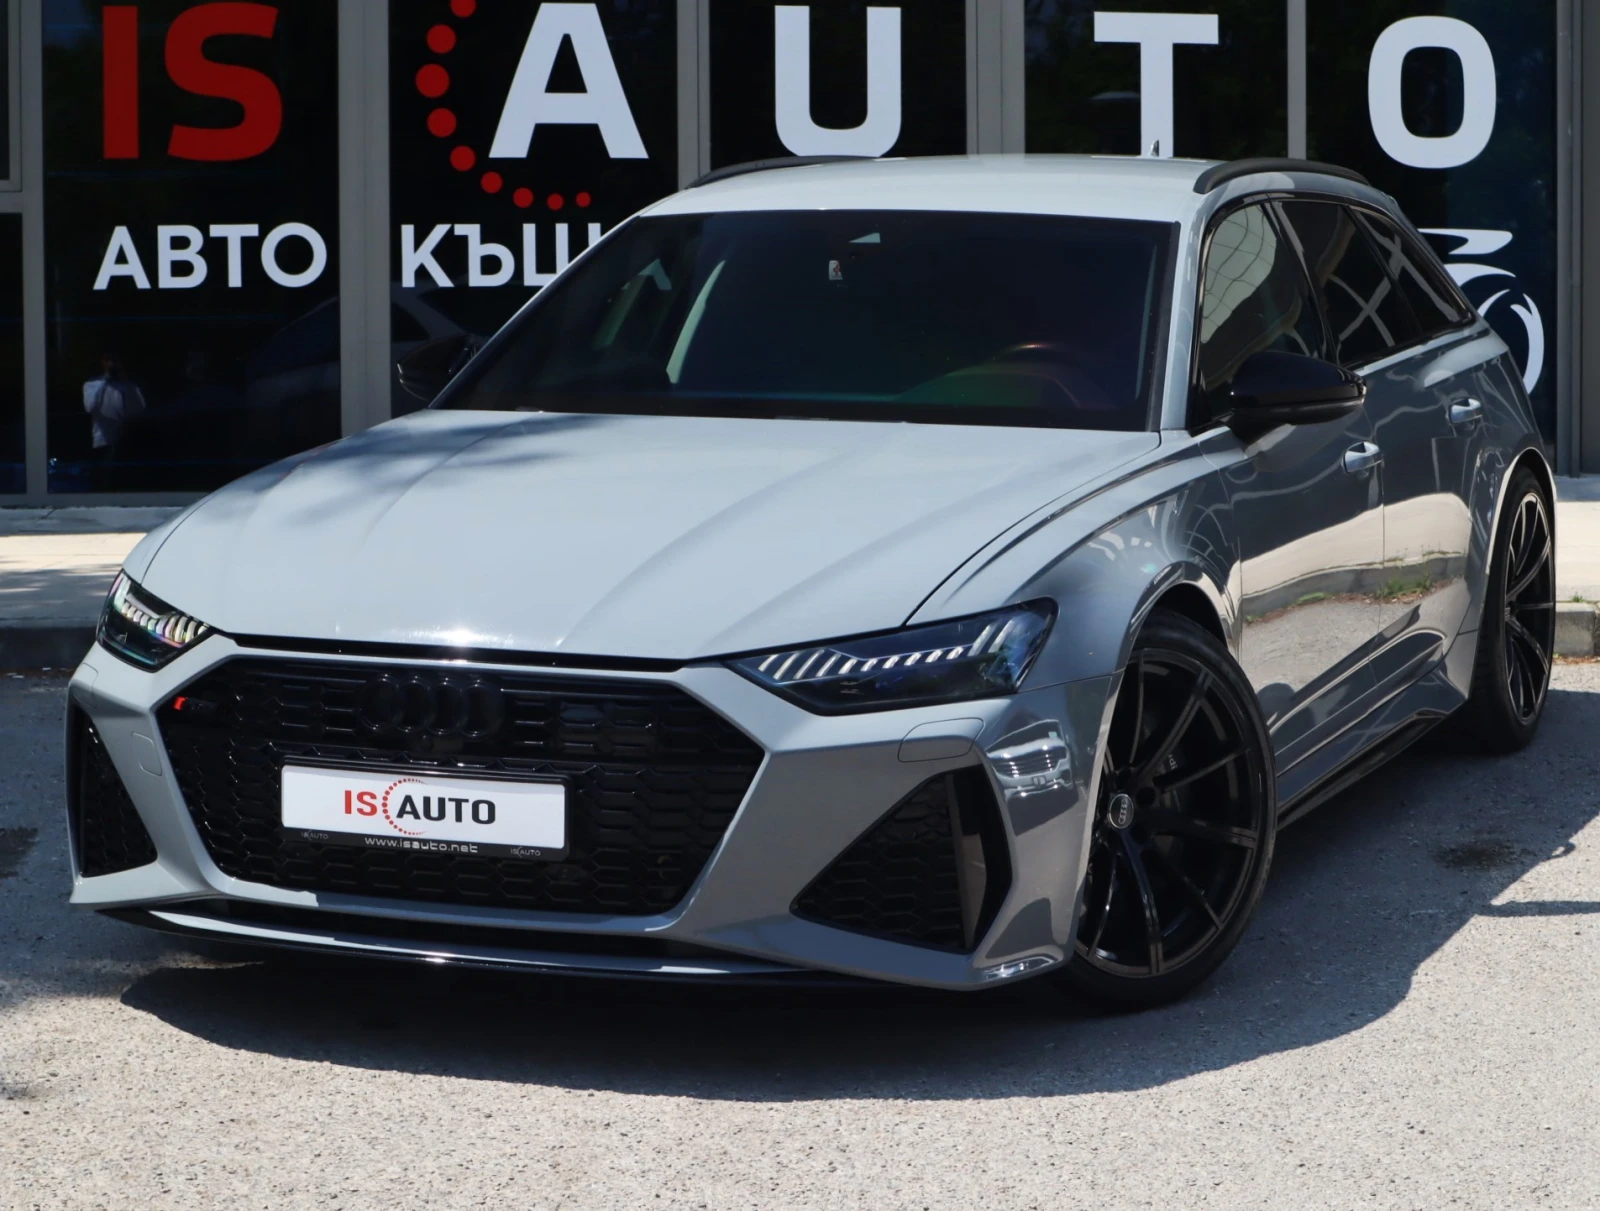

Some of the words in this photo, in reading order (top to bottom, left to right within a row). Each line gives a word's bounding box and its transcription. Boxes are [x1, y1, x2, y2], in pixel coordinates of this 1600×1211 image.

[104, 2, 282, 161] IS
[489, 2, 1495, 168] AUTO
[94, 222, 327, 290] АВТО
[344, 789, 379, 817] IS
[396, 794, 496, 825] AUTO
[364, 837, 478, 854] www.isauto.net
[519, 849, 541, 857] AUTO
